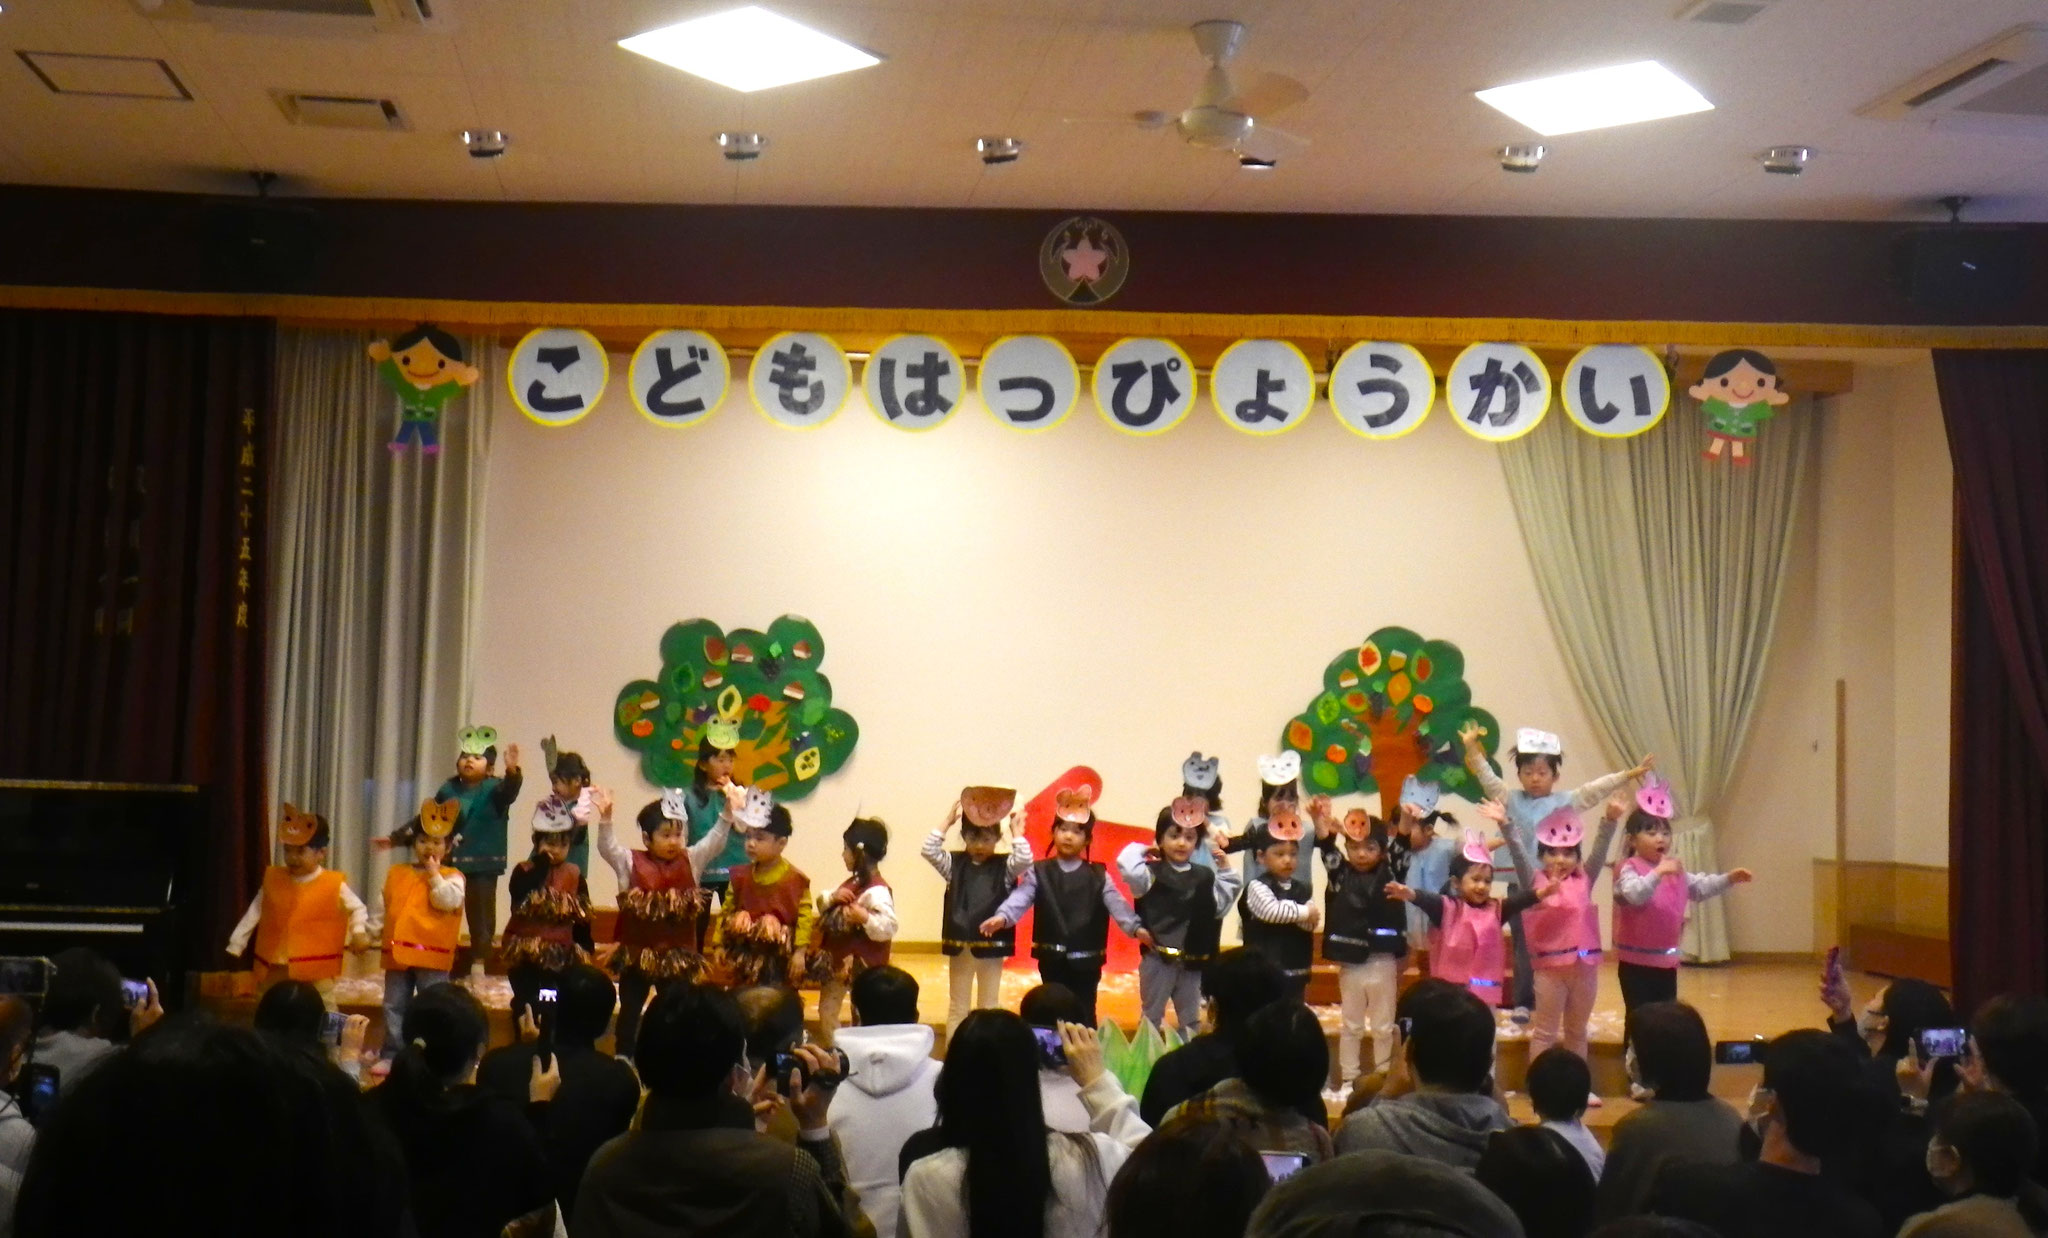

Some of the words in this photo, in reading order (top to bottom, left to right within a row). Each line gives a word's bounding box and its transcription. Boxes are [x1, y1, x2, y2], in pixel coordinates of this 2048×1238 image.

[526, 342, 1652, 428] こどもはっぴょうかい
[236, 408, 255, 628] 平成二十五年度
